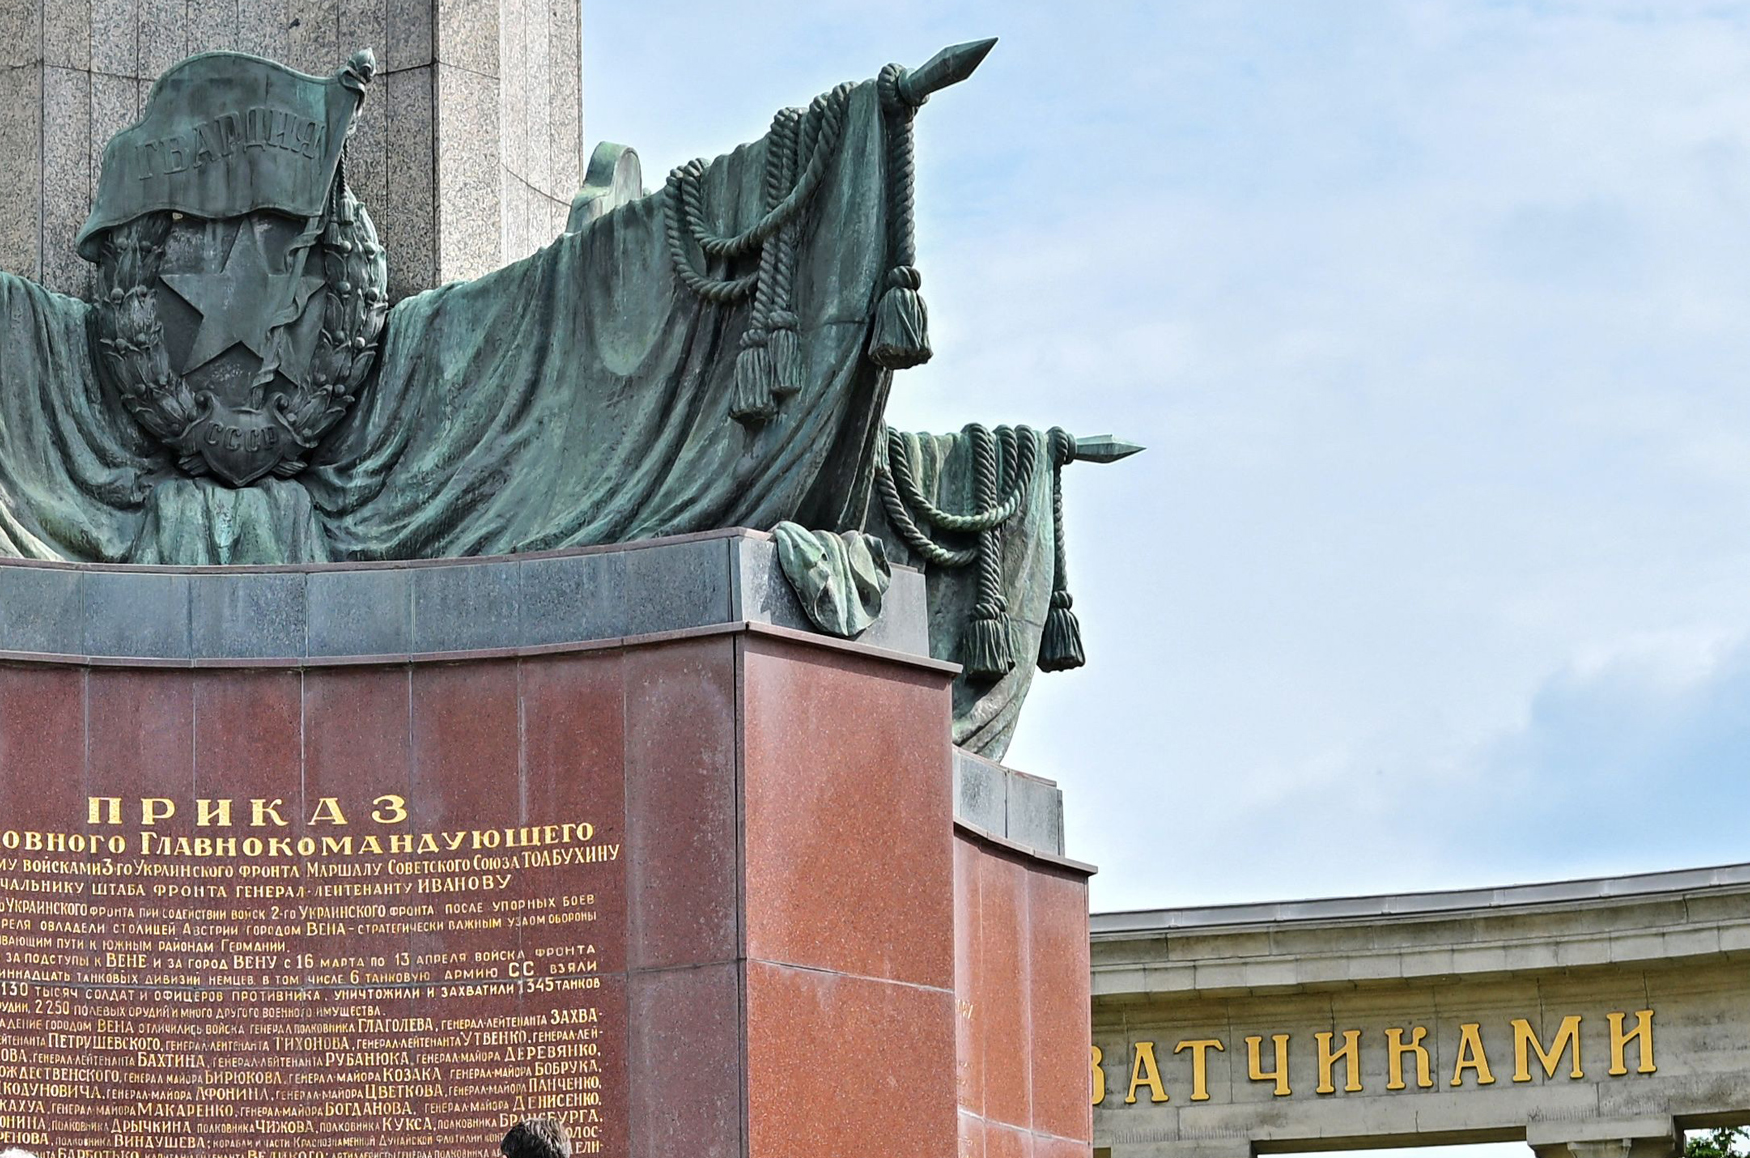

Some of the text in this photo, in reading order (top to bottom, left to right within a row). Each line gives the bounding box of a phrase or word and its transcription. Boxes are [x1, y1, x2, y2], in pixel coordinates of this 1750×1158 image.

[134, 106, 326, 181] ГВАРДИЯ
[203, 420, 280, 453] СССР
[88, 794, 408, 827] ПРИКАЗ
[139, 821, 594, 857] ГЛАВНОКОМАНДУЮЩЕГО
[23, 855, 100, 875] ВОЙСКАМИ
[133, 860, 233, 878] УКРАИНСКОГО
[238, 864, 299, 879] ФРОНТА
[307, 862, 383, 878] МАРШАЛУ
[388, 857, 470, 875] СОВЕТСКОГО
[474, 853, 519, 871] СОЮЗА
[521, 844, 620, 867] ТОЛБУХИНУ
[92, 882, 145, 897] ШТАБА
[153, 883, 227, 898] ФРОНТА
[417, 874, 511, 894] ИВАНОВУ
[6, 897, 88, 917] УКРАИНСКОГО
[90, 905, 135, 919] ФРОНТА
[299, 905, 386, 919] УКРАИНСКОГО
[389, 904, 434, 917] ФРОНТА
[445, 902, 484, 914] ПОСЛЕ
[492, 898, 556, 912] УПОРНЫХ
[562, 894, 595, 906] БОЕВ
[40, 919, 105, 934] ОВЛАДЕЛИ
[113, 921, 176, 935] СТОЛИЦЕЙ
[246, 924, 300, 937] ГОРОДОМ
[306, 922, 345, 936] ВЕНА
[448, 918, 501, 931] ВАЖНЫМ
[548, 911, 597, 924] ОБОРОНЫ
[24, 952, 89, 967] ПОДСТУПЫ
[105, 952, 147, 968] ВЕНЕ
[188, 958, 228, 970] ГОРОД
[233, 954, 276, 969] ВЕНУ
[296, 953, 314, 969] 16
[320, 957, 365, 968] МАРТА
[416, 953, 466, 965] АПРЕЛЯ
[475, 949, 525, 963] ВОЙСКА
[535, 944, 596, 958] ФРОНТА
[57, 938, 84, 950] ПУТИ
[102, 940, 152, 951] ЮЖНЫМ
[158, 937, 213, 952] РАЙОНАМ
[77, 971, 138, 985] ТАНКОВЫХ
[145, 971, 201, 985] ДИВИЗИЙ
[308, 973, 344, 985] ЧИСЛЕ
[365, 971, 431, 983] ТАНКОВУЮ
[444, 967, 498, 980] АРМИЮ
[508, 961, 534, 978] СС
[550, 961, 597, 975] ВЗЯЛИ
[1, 982, 29, 997] 130
[34, 986, 78, 999] ТЫСЯЧ
[85, 989, 134, 1001] СОЛДАТ
[154, 989, 223, 1003] ОФИЦЕРОВ
[334, 986, 420, 1000] УНИЧТОЖИЛИ
[441, 983, 514, 998] ЗАХВАТИЛИ
[554, 978, 601, 991] ТАНКОВ
[74, 1003, 125, 1017] ПОЛЕВЫХ
[97, 1018, 134, 1033] ВЕНА
